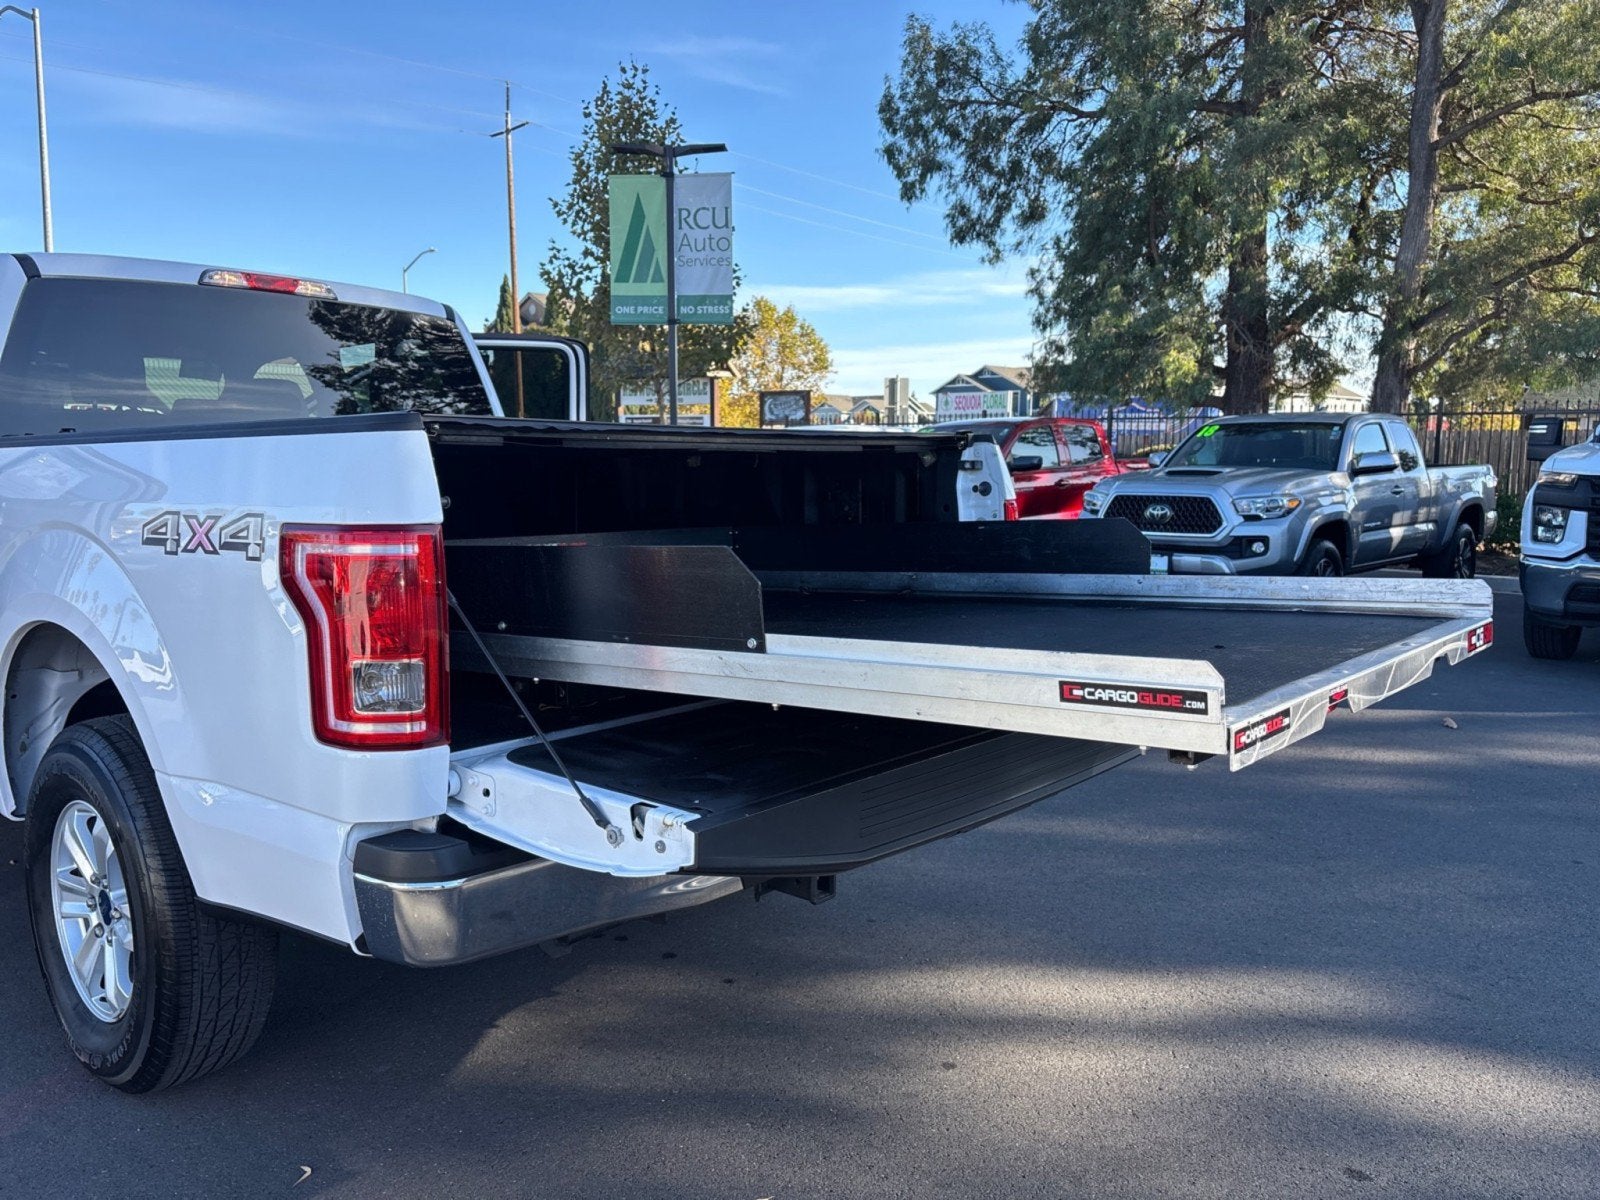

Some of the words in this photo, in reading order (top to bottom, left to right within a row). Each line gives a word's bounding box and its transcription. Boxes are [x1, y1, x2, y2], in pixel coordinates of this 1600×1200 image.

[678, 207, 729, 230] RCU
[678, 233, 731, 252] Auto
[678, 255, 731, 267] Services
[615, 305, 635, 314] ONE
[637, 305, 664, 314] PRICE
[680, 305, 695, 314] NO
[697, 305, 730, 314] STRESS
[954, 395, 981, 411] SEQUOIA
[983, 393, 1006, 409] FLORAL
